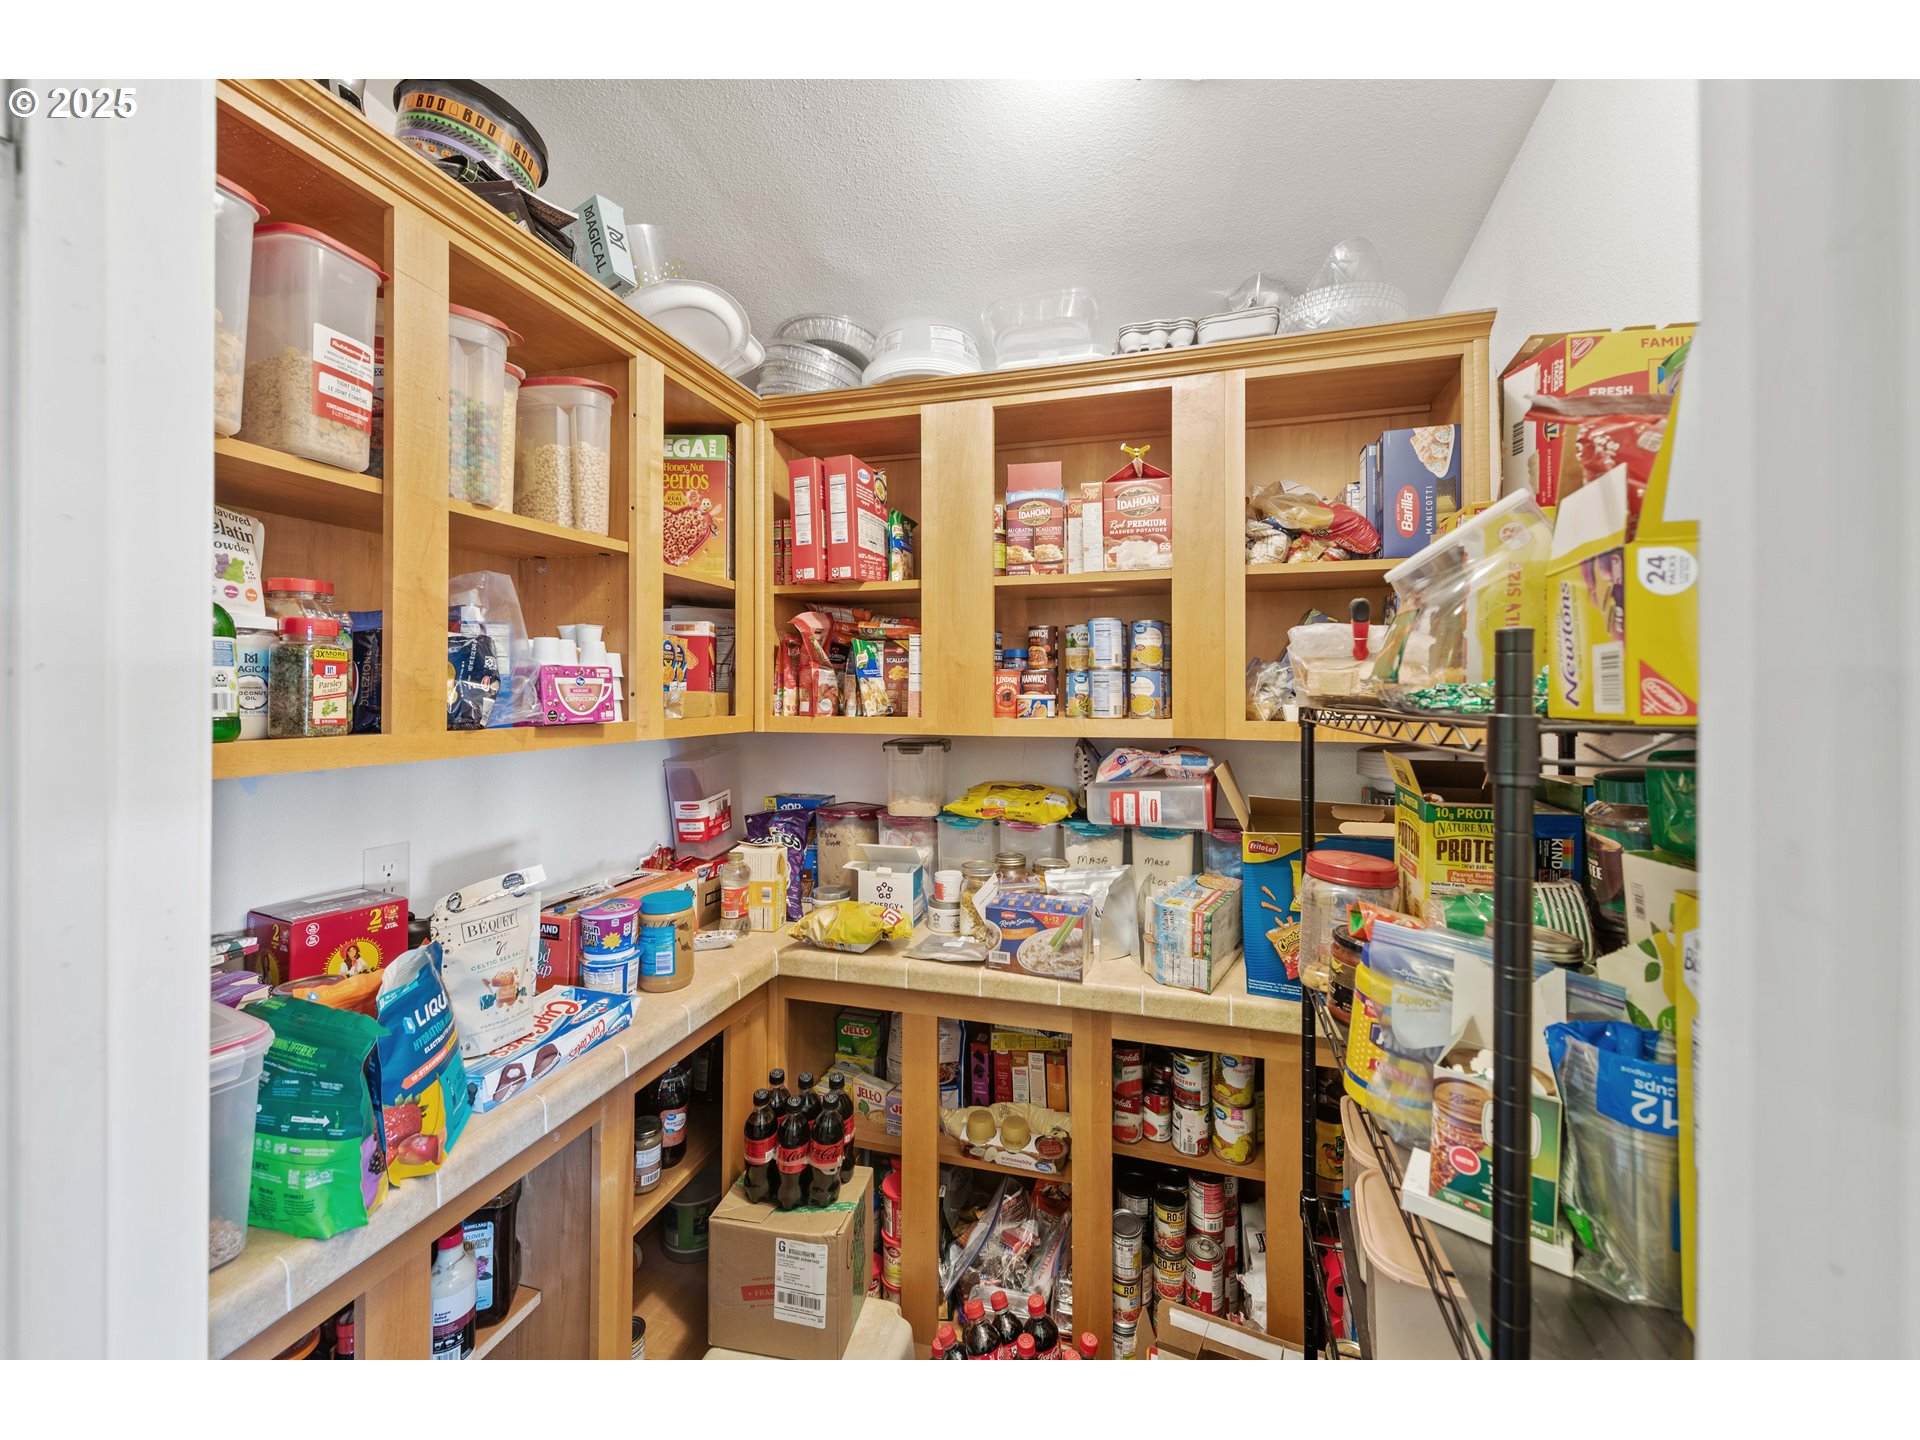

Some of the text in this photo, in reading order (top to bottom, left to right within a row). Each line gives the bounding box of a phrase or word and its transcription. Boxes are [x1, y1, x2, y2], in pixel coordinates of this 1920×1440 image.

[416, 93, 446, 112] BOO
[462, 107, 497, 138] BOO
[513, 141, 534, 172] BOO
[583, 204, 609, 274] MAGICAL
[1589, 386, 1633, 396] FRESH
[709, 439, 717, 458] SIZE
[664, 463, 704, 473] Honey Nut
[663, 470, 709, 490] eerios
[1117, 495, 1160, 511] IDAHOAN
[1400, 489, 1413, 532] Barilla
[213, 508, 252, 527] lavored
[1018, 508, 1051, 519] IDAHOAN
[213, 520, 254, 544] elatin
[1110, 519, 1167, 530] Real PREMIUM
[213, 540, 250, 555] owder
[1646, 555, 1666, 584] 24
[1560, 582, 1580, 707] Newtons
[316, 650, 325, 658] 3X
[238, 665, 269, 673] AGICA
[318, 680, 343, 689] Parsley
[1435, 808, 1494, 820] 10g PROTE
[1438, 822, 1494, 836] NATURE VAL
[1077, 855, 1109, 865] MASA
[1436, 839, 1494, 864] PROTE
[1551, 838, 1563, 870] KIND
[1144, 857, 1170, 867] MASA
[370, 908, 381, 925] 2
[272, 924, 279, 941] 2
[467, 913, 514, 938] BÉQUET
[540, 924, 559, 934] AND
[582, 925, 600, 935] aisin
[1278, 931, 1301, 952] Cheeto
[471, 949, 524, 971] CELTIC SEA SALT
[415, 990, 448, 1027] LIQU
[1634, 1078, 1677, 1098] cups
[1631, 1090, 1679, 1130] 12
[463, 1237, 492, 1251] ONEY
[465, 1233, 485, 1241] CLOVER
[778, 1240, 786, 1252] G
